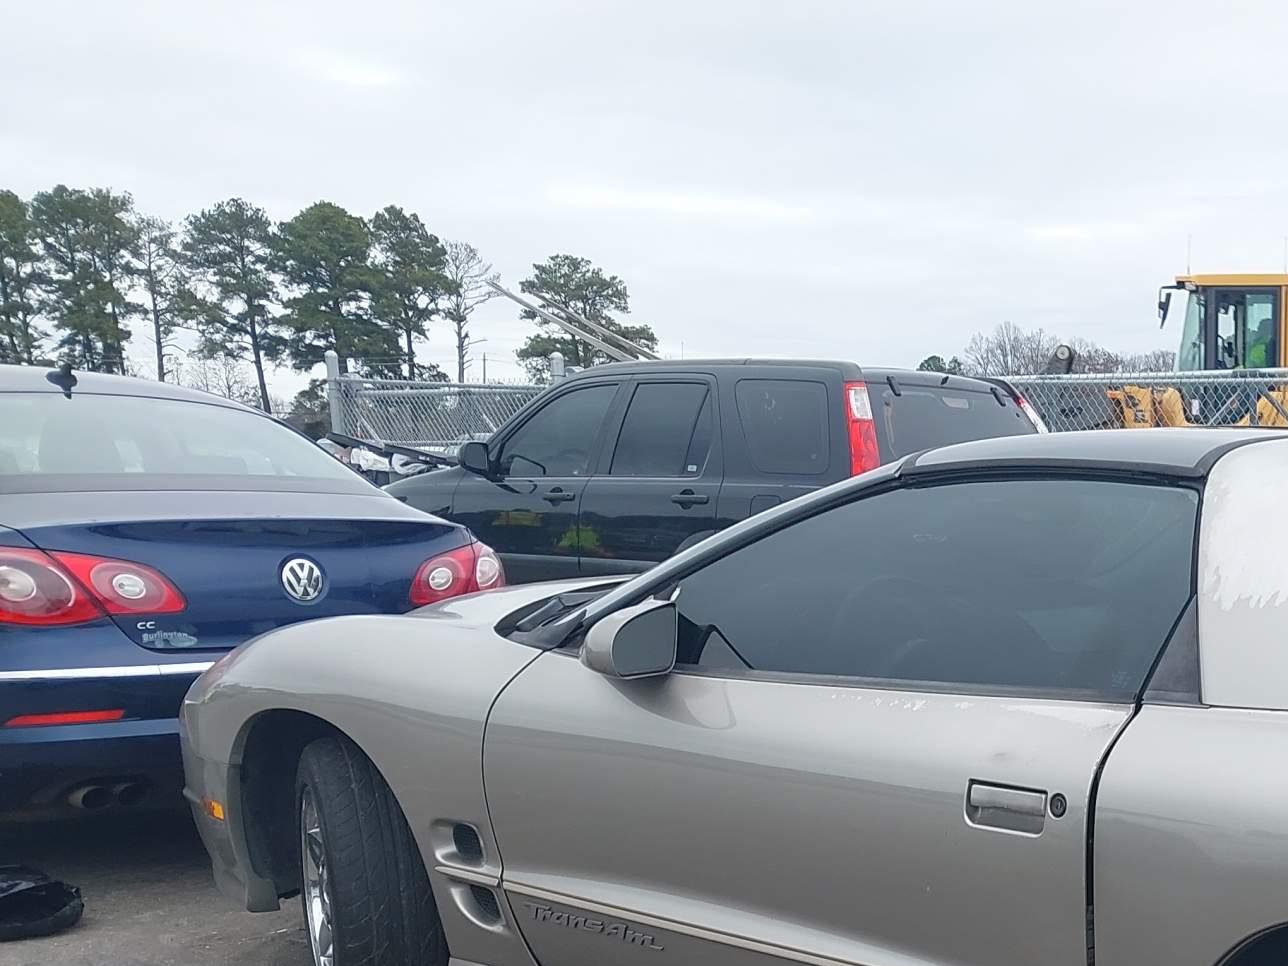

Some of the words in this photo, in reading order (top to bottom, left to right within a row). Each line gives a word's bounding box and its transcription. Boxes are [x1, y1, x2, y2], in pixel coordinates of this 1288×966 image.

[281, 558, 323, 601] VW
[136, 621, 156, 630] CC
[525, 901, 604, 934] Trans
[606, 922, 665, 951] Am
